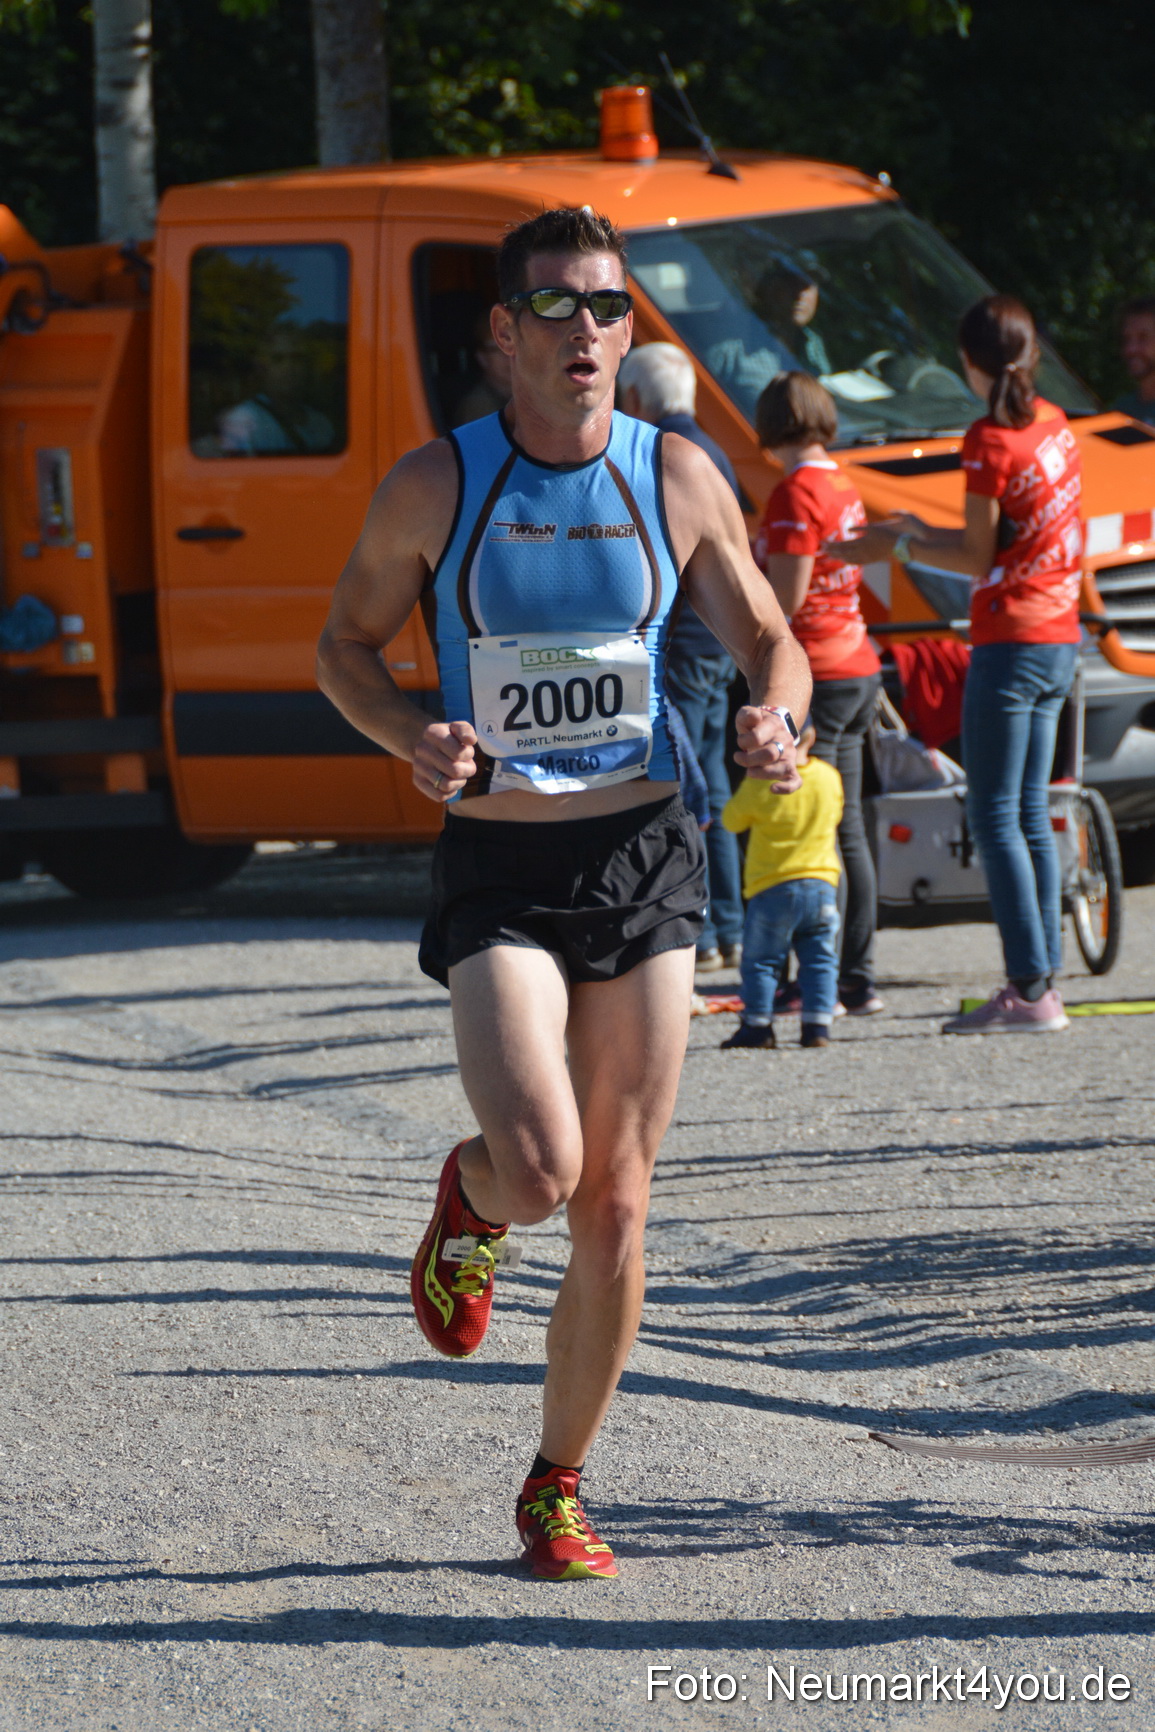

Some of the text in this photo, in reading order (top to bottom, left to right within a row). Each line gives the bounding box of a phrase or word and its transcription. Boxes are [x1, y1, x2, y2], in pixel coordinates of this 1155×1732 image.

[604, 523, 637, 539] RACER
[520, 647, 597, 667] BOCK
[521, 665, 546, 674] inspired
[555, 663, 573, 671] smart
[573, 661, 600, 670] concepts
[499, 673, 624, 732] 2000
[516, 729, 603, 749] PARTL Neumarkt
[537, 754, 601, 777] Marco
